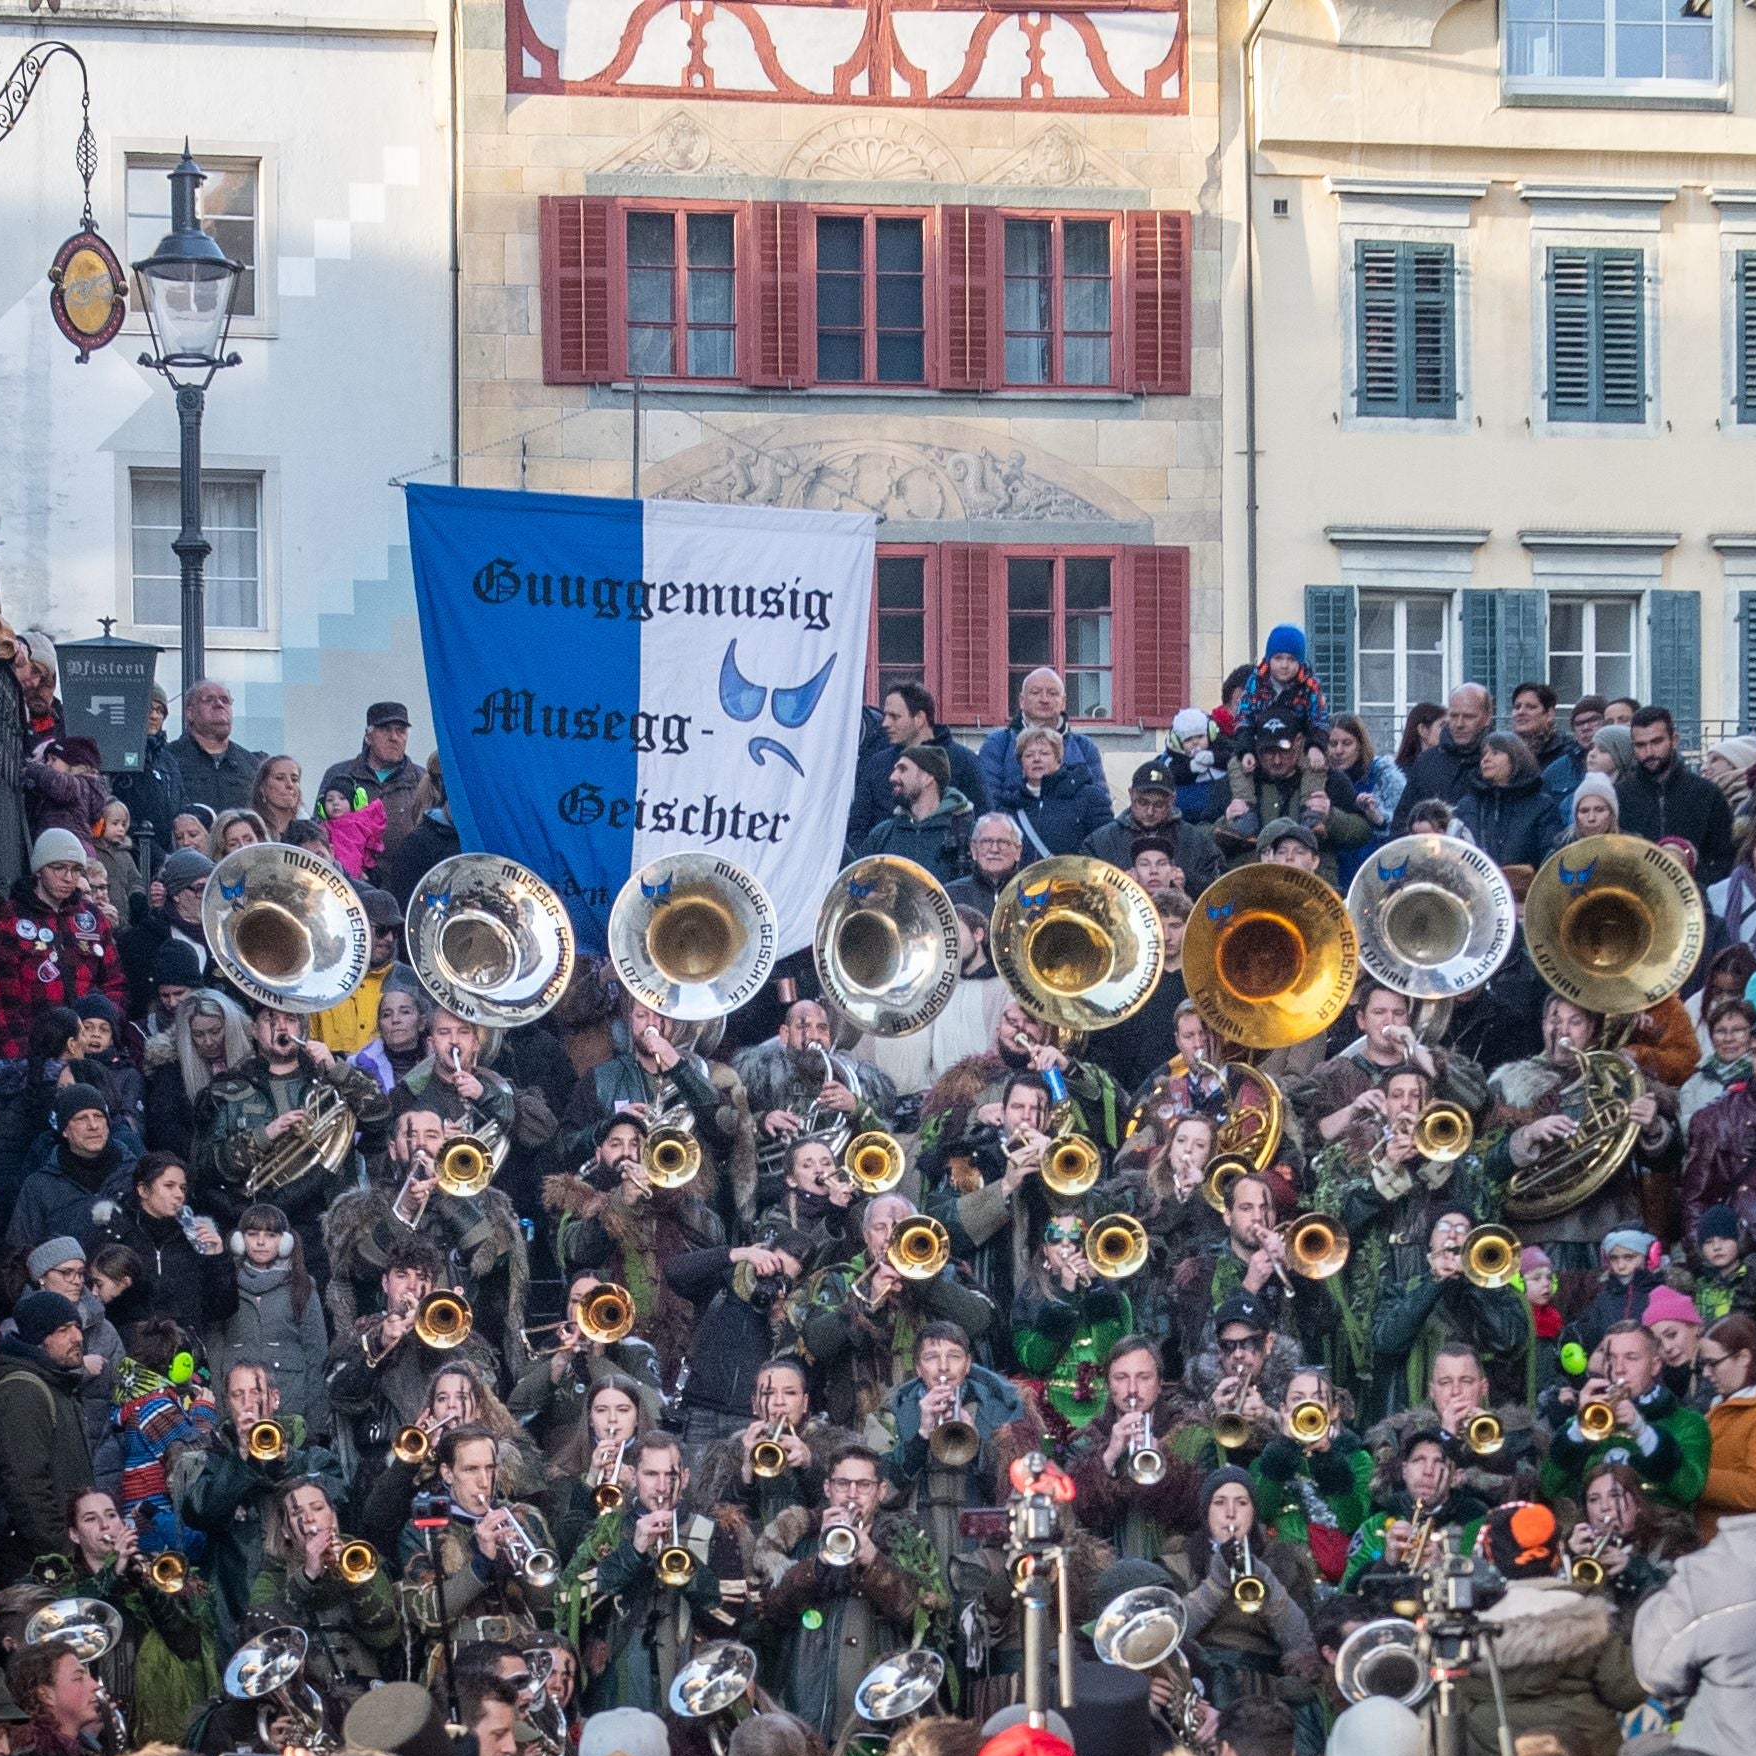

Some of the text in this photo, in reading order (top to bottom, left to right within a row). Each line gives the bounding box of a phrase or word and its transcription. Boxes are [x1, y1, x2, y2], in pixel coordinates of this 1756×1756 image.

[472, 556, 834, 632] Guuggemusig
[66, 659, 146, 677] Pfistern
[557, 781, 791, 845] Geischter
[282, 849, 368, 992] MUSEGG-GEISCHTER
[714, 860, 775, 1006] MUSEGG-GEISCHTER
[891, 887, 960, 1034] MUSEGG-GEISCHTER
[1454, 848, 1512, 988] MUSEGG-GEISCHTER
[1643, 847, 1702, 1004] MUSEGG-GEISCHTER
